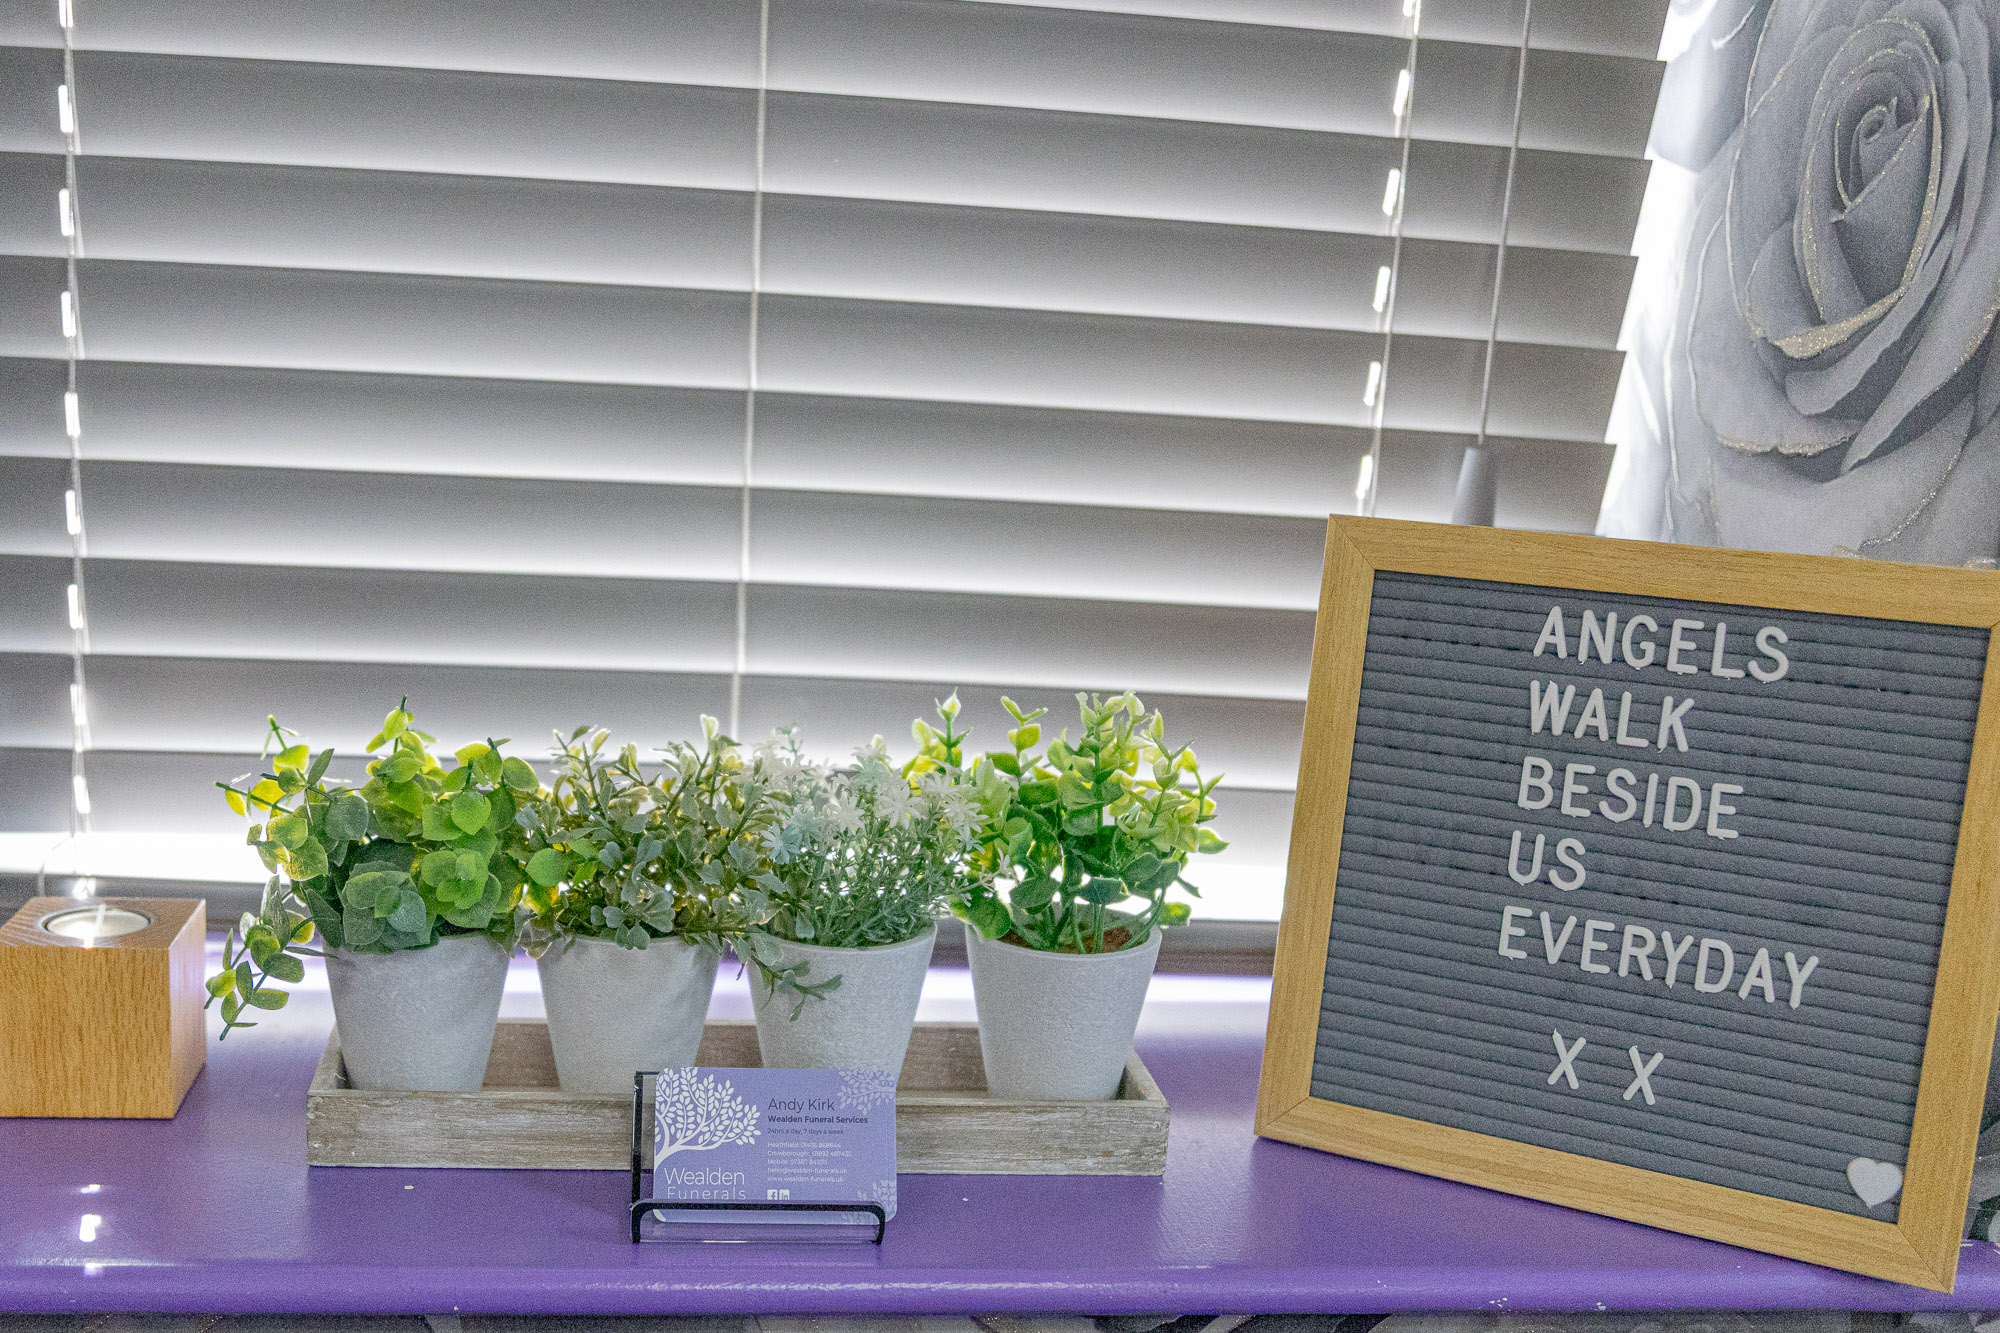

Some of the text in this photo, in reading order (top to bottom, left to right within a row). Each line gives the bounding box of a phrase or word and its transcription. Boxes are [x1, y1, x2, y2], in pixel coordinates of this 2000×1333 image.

[1533, 605, 1789, 683] ANGELS
[1530, 680, 1695, 752] WALK
[1517, 756, 1744, 840] BESIDE
[1507, 830, 1587, 891] US
[1499, 905, 1819, 1008] EVERYDAY
[1547, 1029, 1664, 1105] X X
[767, 1098, 835, 1113] Andy Kirk
[767, 1115, 868, 1124] Wealden Funeral Services
[809, 1128, 822, 1136] days
[664, 1167, 745, 1185] Wealden
[667, 1186, 746, 1200] Funerals
